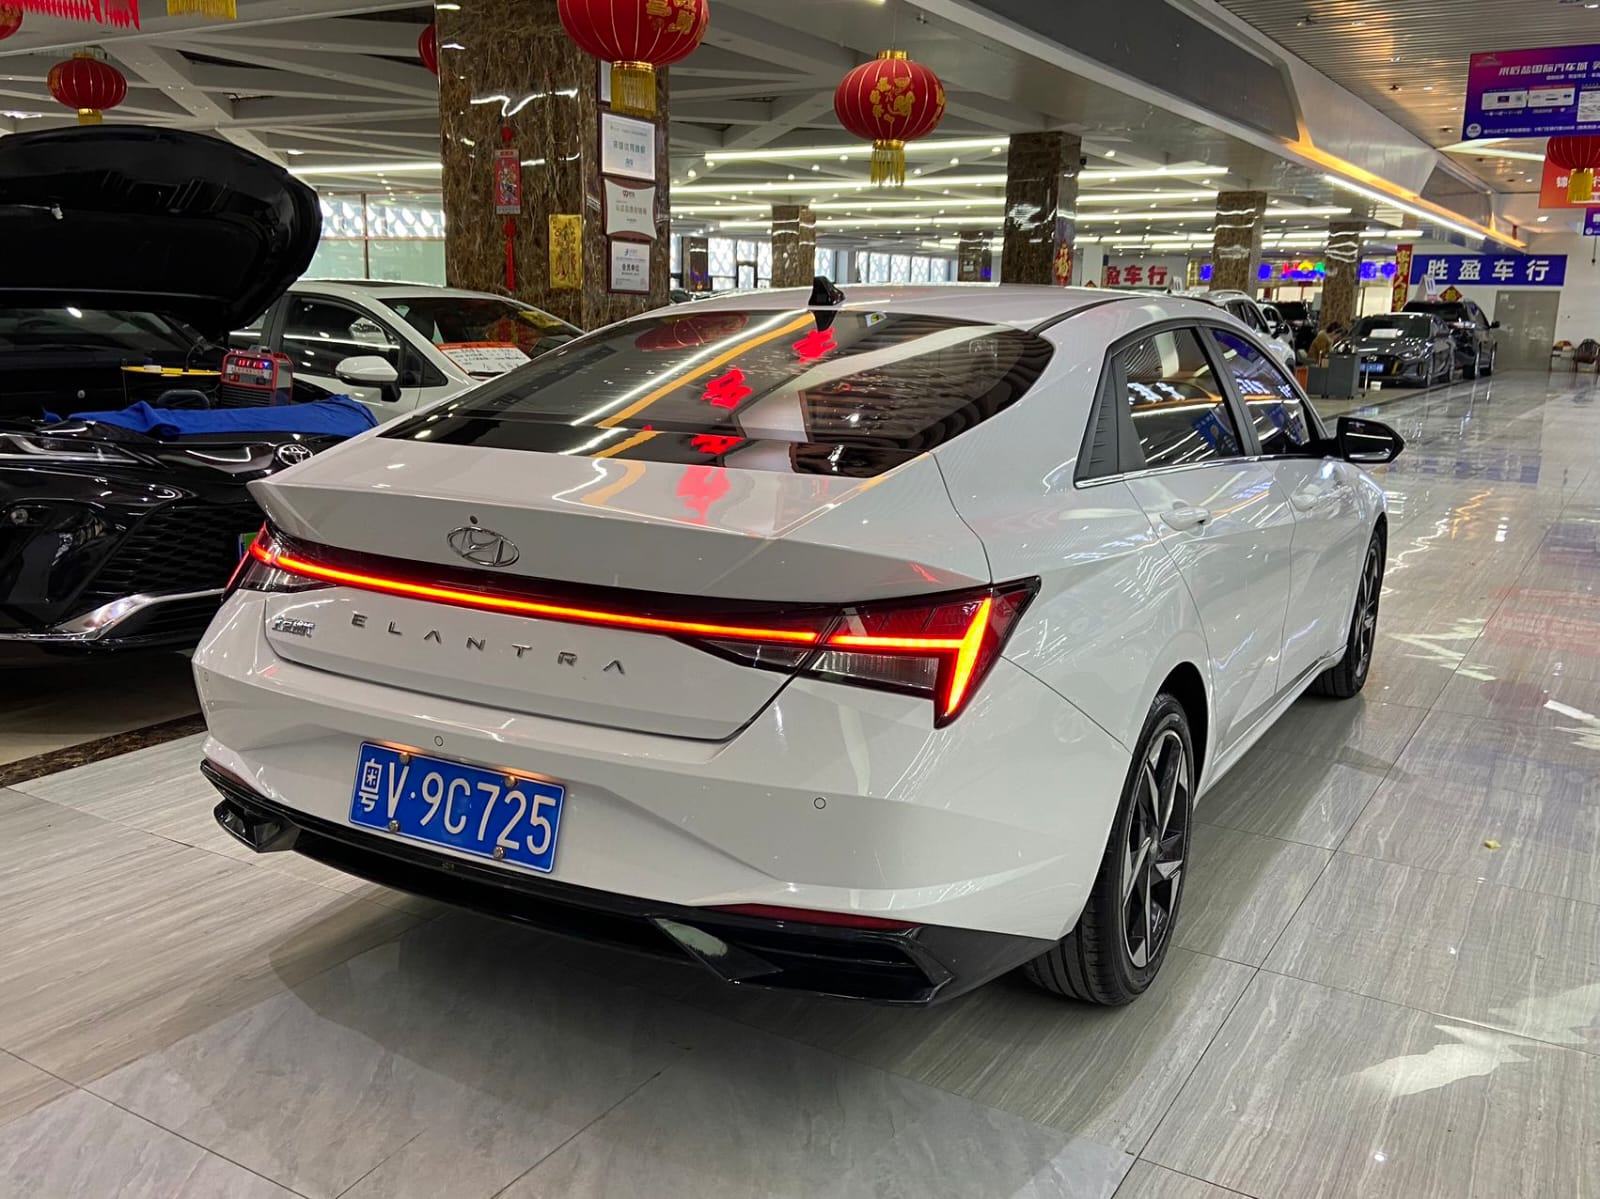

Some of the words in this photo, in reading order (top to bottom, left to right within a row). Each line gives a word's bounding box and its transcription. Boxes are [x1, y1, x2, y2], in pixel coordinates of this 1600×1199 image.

[1426, 258, 1550, 281] 胜盈车行
[351, 612, 625, 675] ELANTRA
